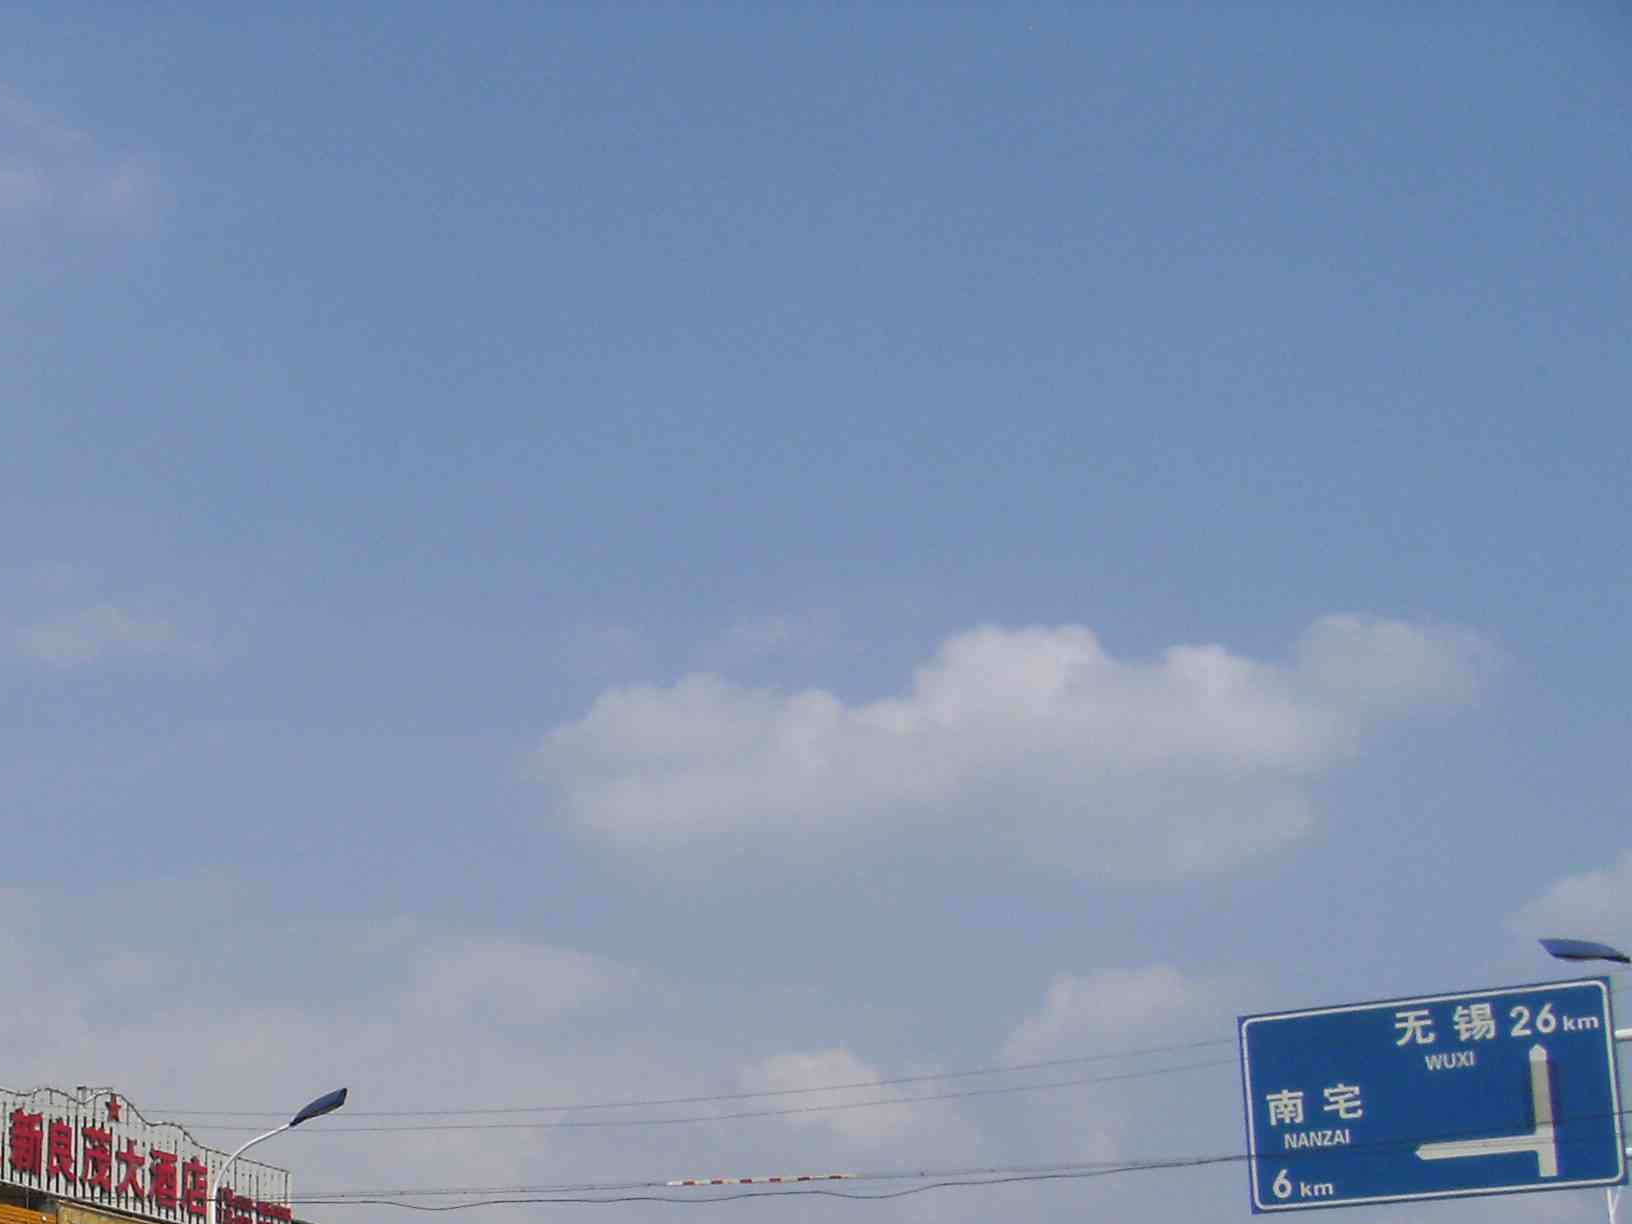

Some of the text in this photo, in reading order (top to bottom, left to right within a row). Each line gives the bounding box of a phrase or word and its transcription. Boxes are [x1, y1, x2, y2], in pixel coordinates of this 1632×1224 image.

[1394, 1003, 1600, 1047] 无锡 26 km
[1425, 1050, 1476, 1071] WUXI
[1266, 1083, 1364, 1126] 南宅
[1283, 1129, 1351, 1150] NANZAI
[9, 1107, 209, 1216] 新良茂大酒店
[1272, 1168, 1334, 1198] 6 km
